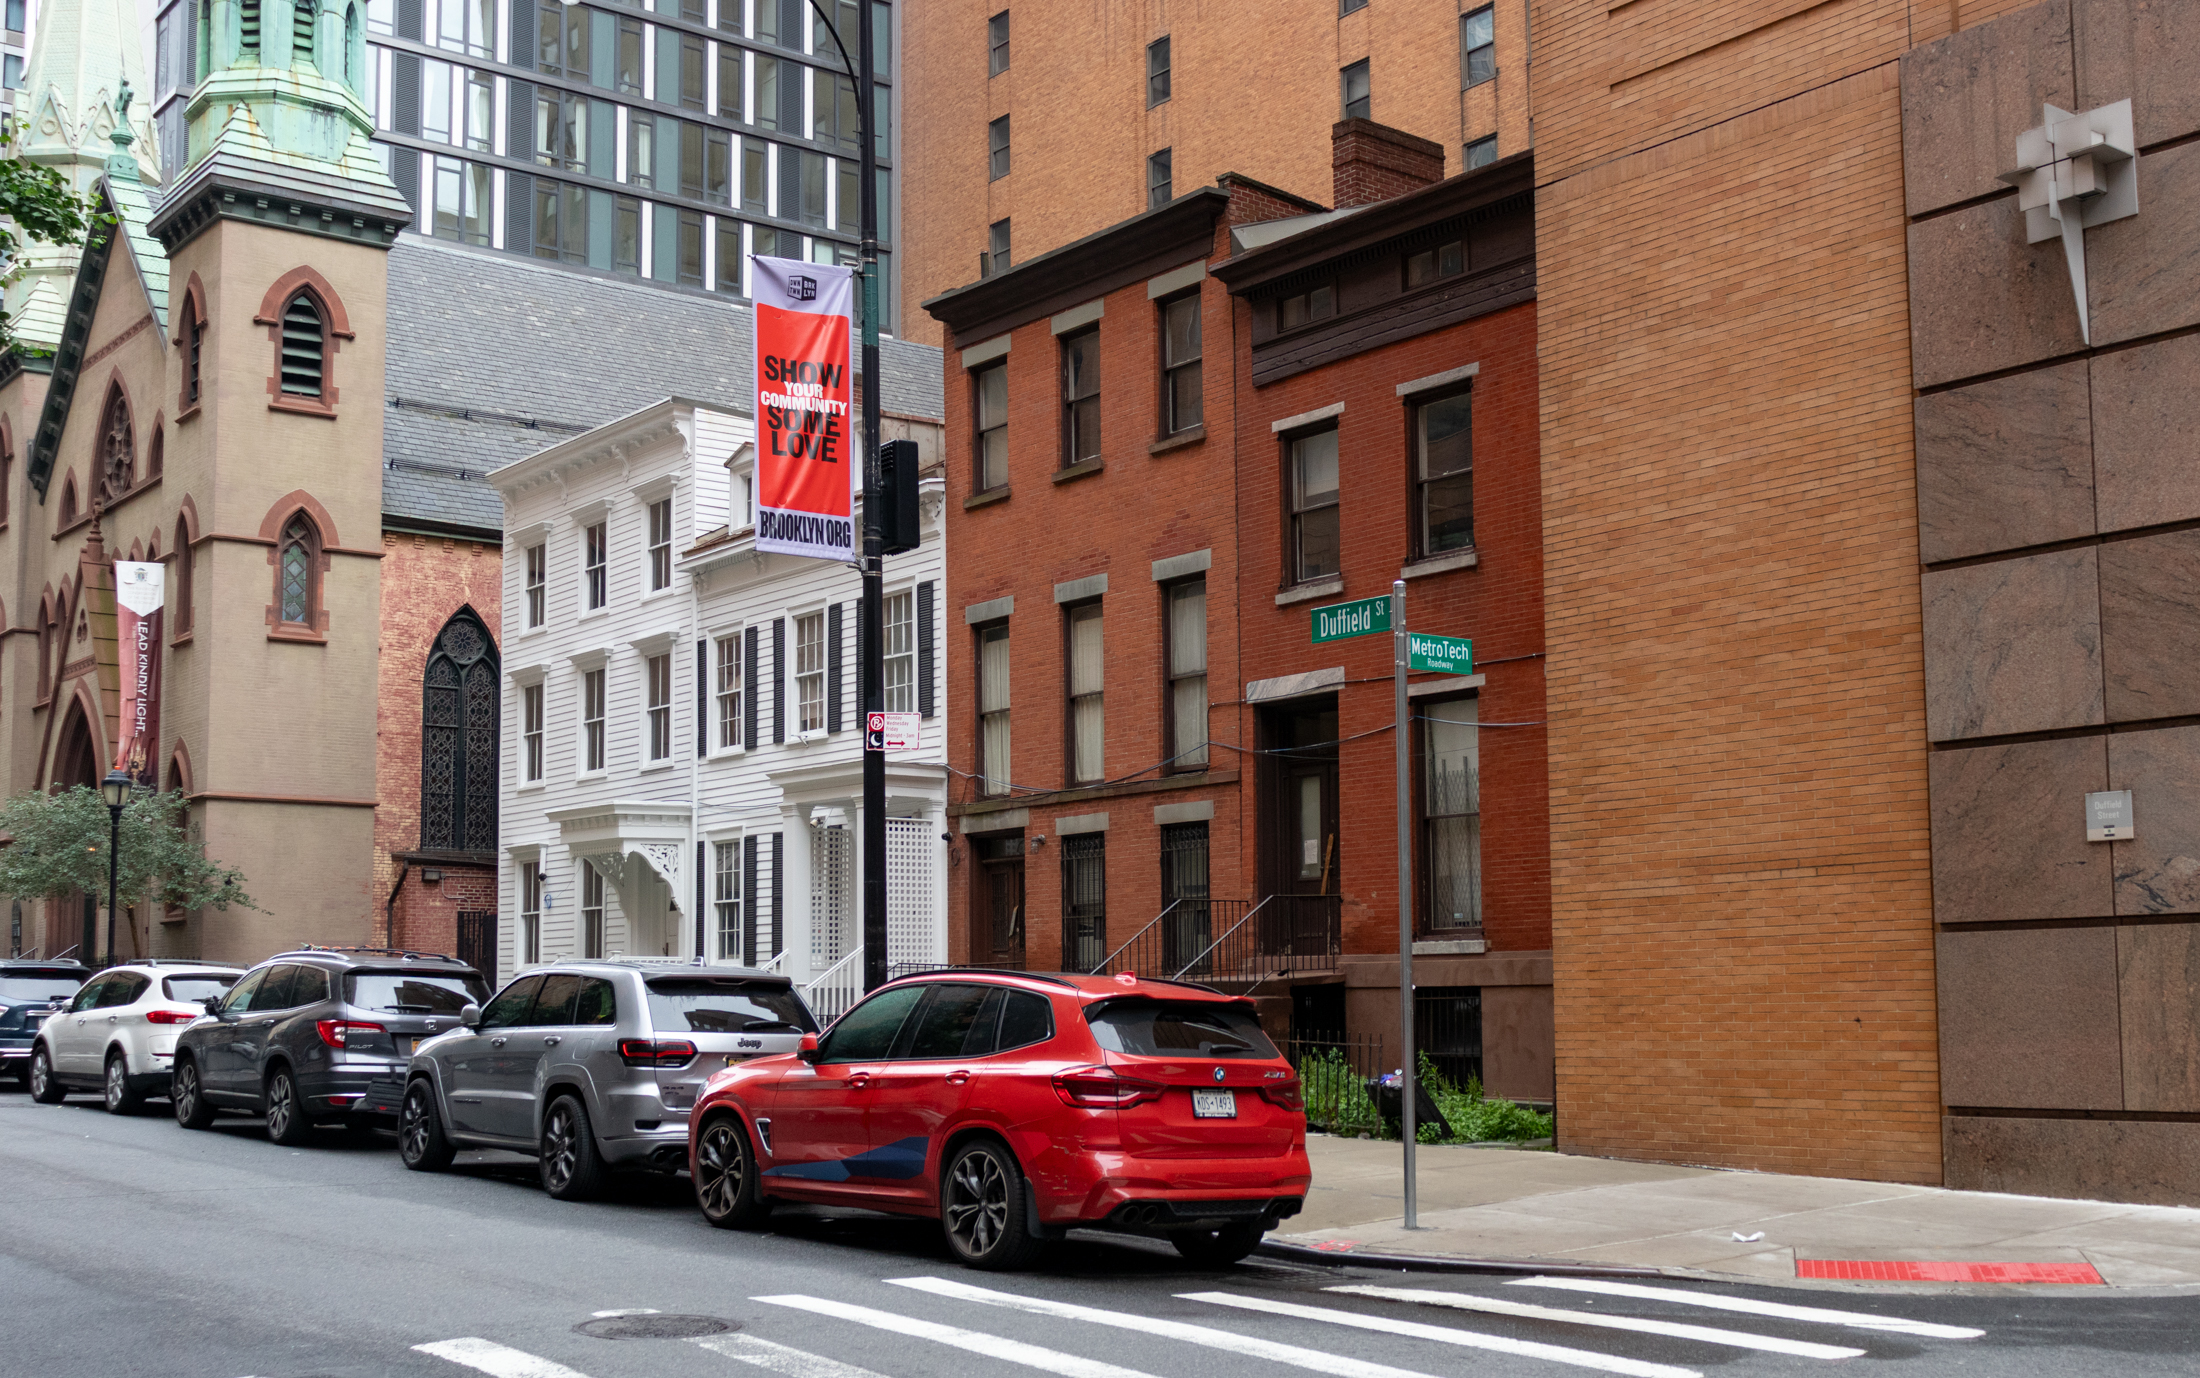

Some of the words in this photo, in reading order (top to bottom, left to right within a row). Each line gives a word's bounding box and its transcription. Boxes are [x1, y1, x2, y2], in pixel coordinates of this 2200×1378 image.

[803, 280, 816, 289] BRK
[764, 355, 842, 388] SHOW
[784, 381, 823, 398] YOUR
[761, 391, 847, 416] COMMUNITY
[767, 404, 841, 437] SOME
[771, 430, 837, 463] LOVE
[759, 510, 825, 545] BROOKLYN
[826, 519, 851, 548] ORG
[1320, 604, 1370, 638] Duffield
[1375, 600, 1384, 616] St
[137, 621, 148, 651] LEAD
[1411, 637, 1469, 660] MetroTech
[137, 653, 148, 696] KINDLY
[1427, 658, 1454, 671] Roadway
[2094, 800, 2122, 810] Duffield
[2097, 811, 2120, 820] Street
[737, 1038, 763, 1050] Jeep
